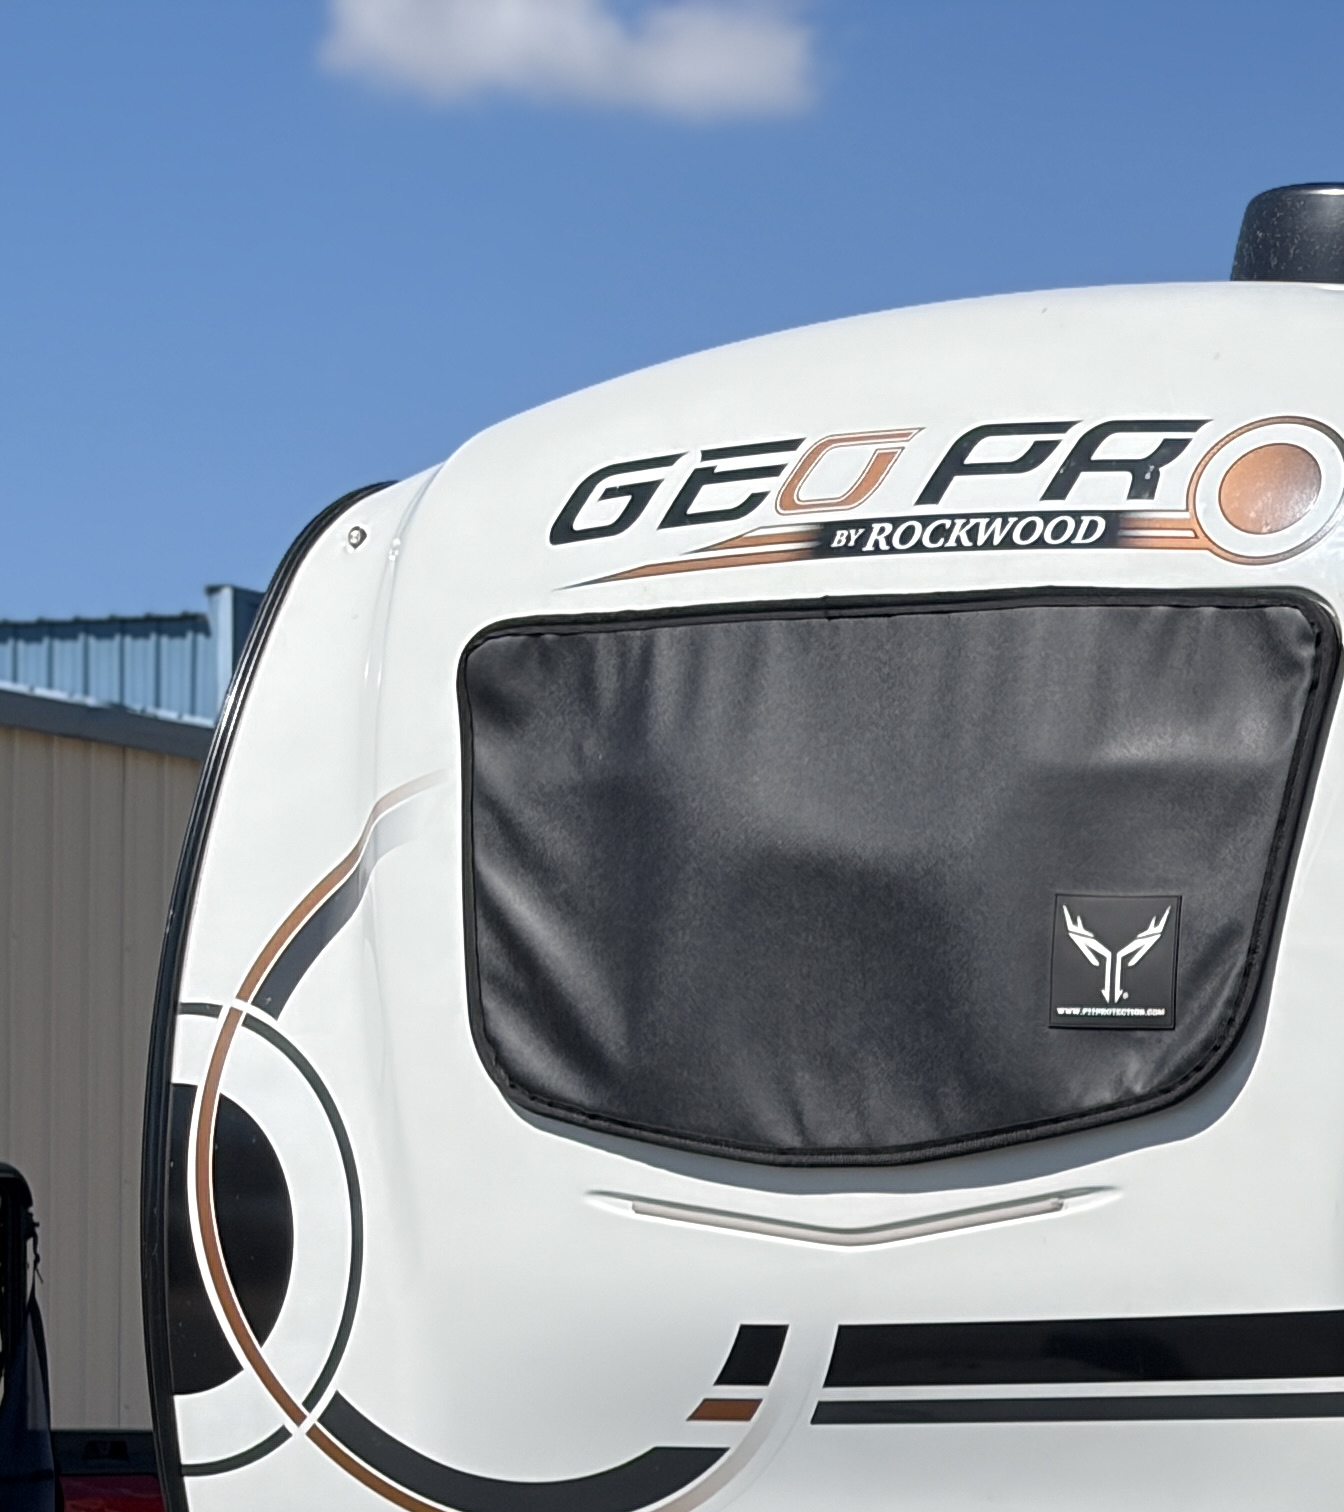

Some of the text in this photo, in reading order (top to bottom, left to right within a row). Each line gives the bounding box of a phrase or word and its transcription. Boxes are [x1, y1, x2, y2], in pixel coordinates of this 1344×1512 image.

[548, 427, 926, 546] GEO
[830, 514, 1108, 553] BY ROCKWOOD
